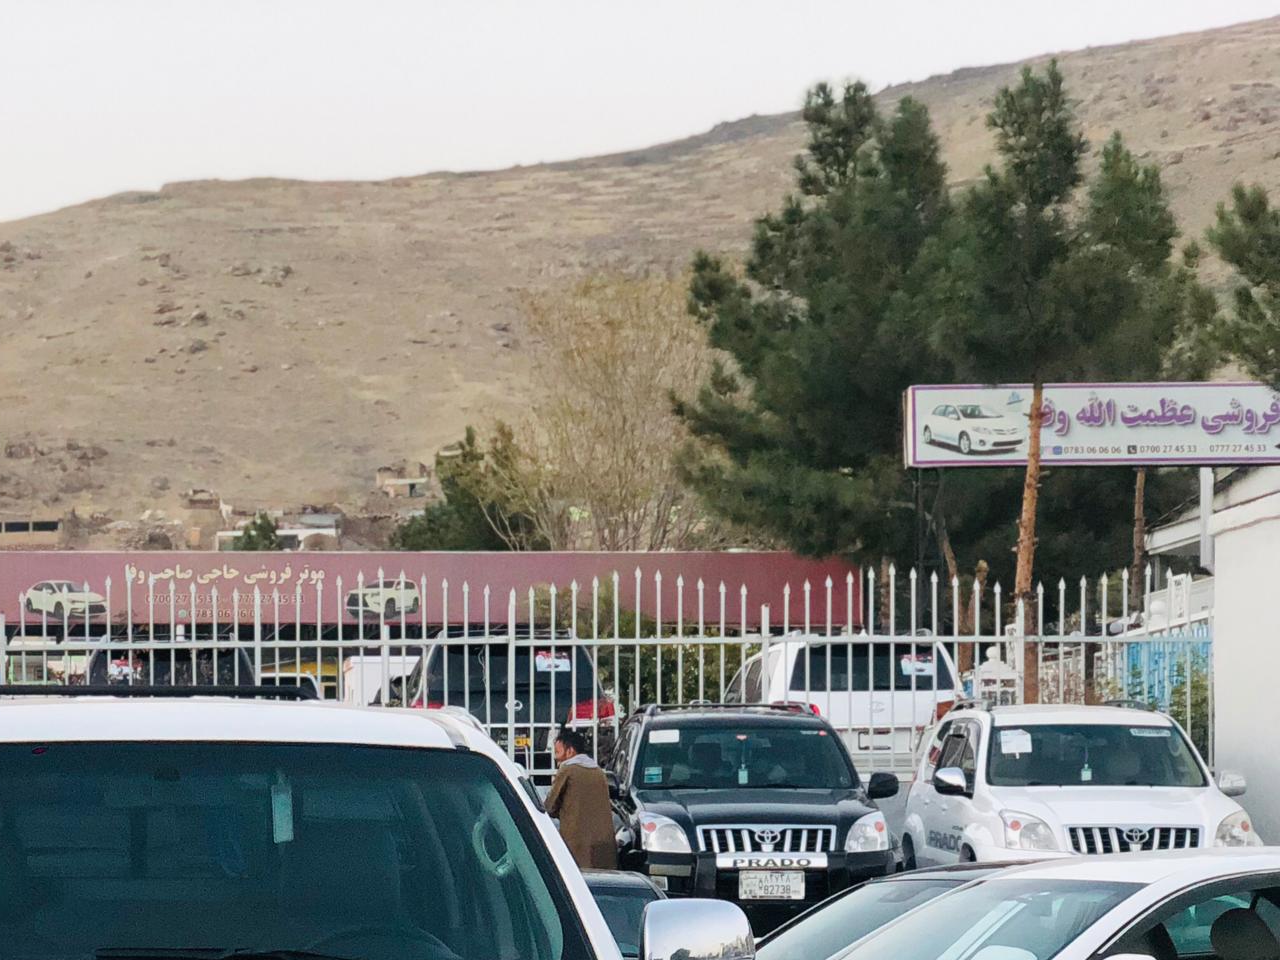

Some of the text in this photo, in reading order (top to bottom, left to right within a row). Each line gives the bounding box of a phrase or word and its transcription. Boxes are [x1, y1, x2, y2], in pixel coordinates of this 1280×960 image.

[1076, 391, 1116, 427] الله
[1120, 397, 1197, 428] عظمت
[197, 564, 239, 584] حاجی
[244, 562, 292, 584] فروشی
[296, 564, 325, 584] موتر
[733, 858, 811, 868] PRADO
[763, 885, 791, 895] 82738
